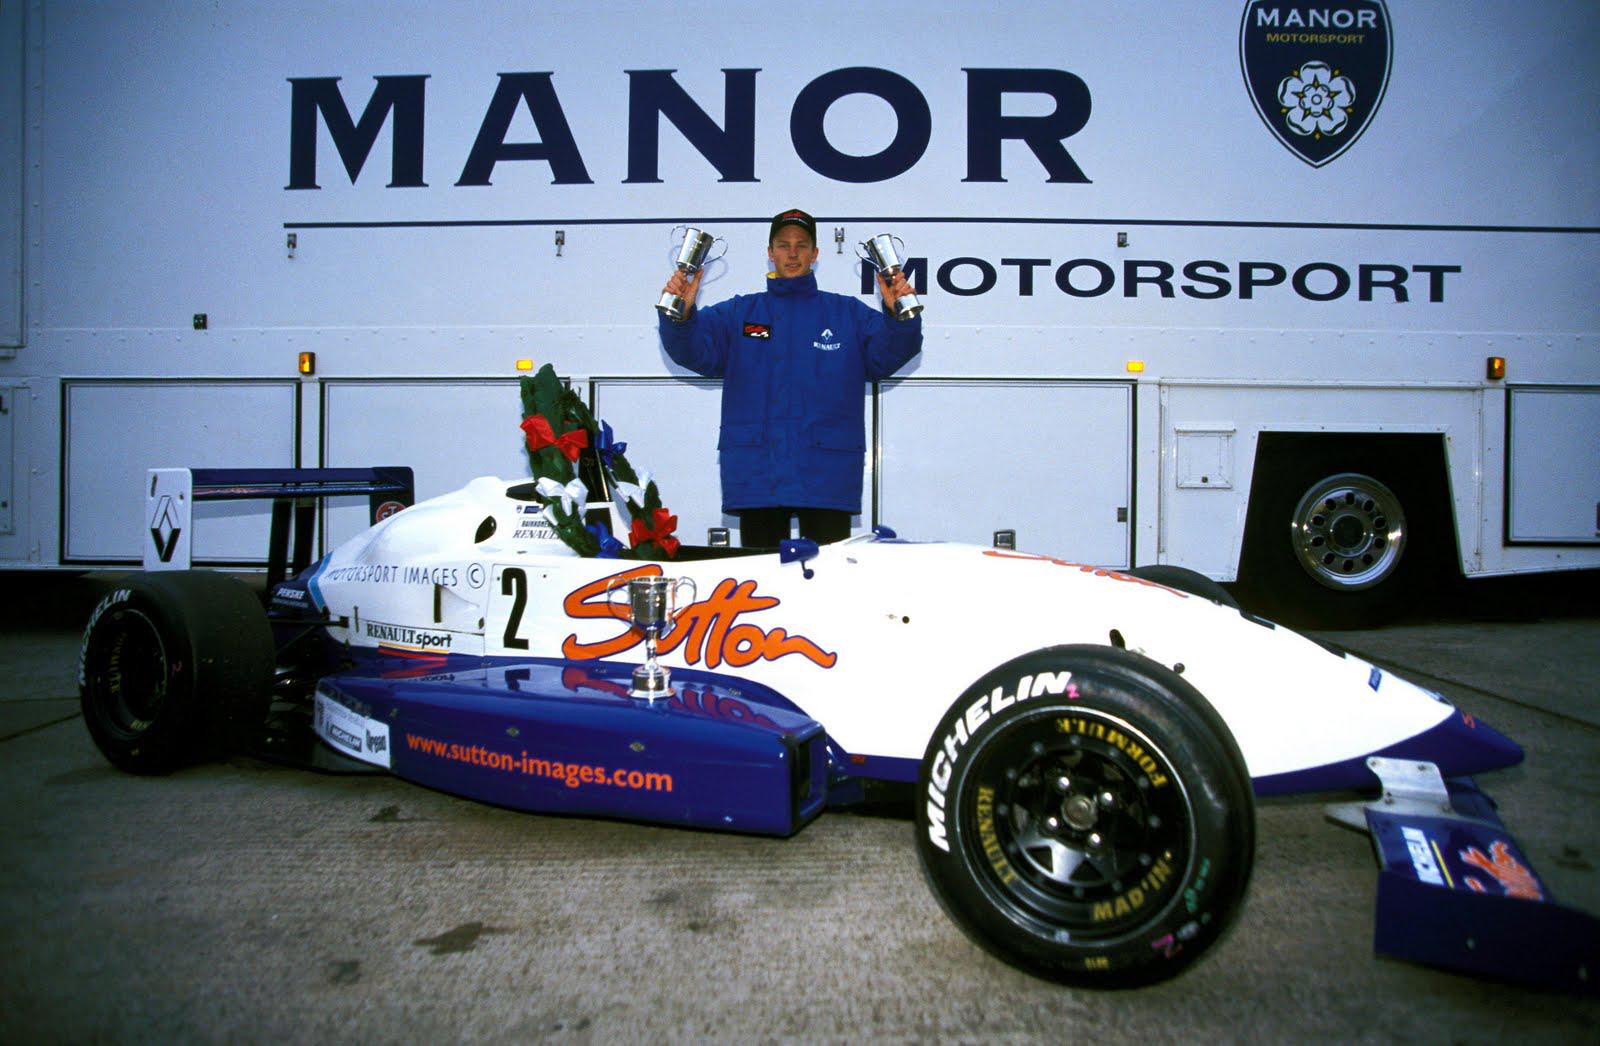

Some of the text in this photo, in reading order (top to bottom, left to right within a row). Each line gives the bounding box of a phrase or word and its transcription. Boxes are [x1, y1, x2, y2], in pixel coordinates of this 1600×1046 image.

[1257, 8, 1377, 28] MANOR
[1266, 33, 1366, 44] MOTORSPORT
[284, 67, 1093, 190] MANOR
[861, 256, 1461, 303] MOTORSPORT
[403, 566, 458, 588] IMAGES
[366, 623, 452, 649] RENAULT sport
[501, 567, 530, 650] 2
[561, 563, 838, 669] Sutton
[406, 733, 673, 792] www.sutton-images.com
[926, 671, 1072, 853] MICHELIN
[976, 786, 1015, 886] RENAULT
